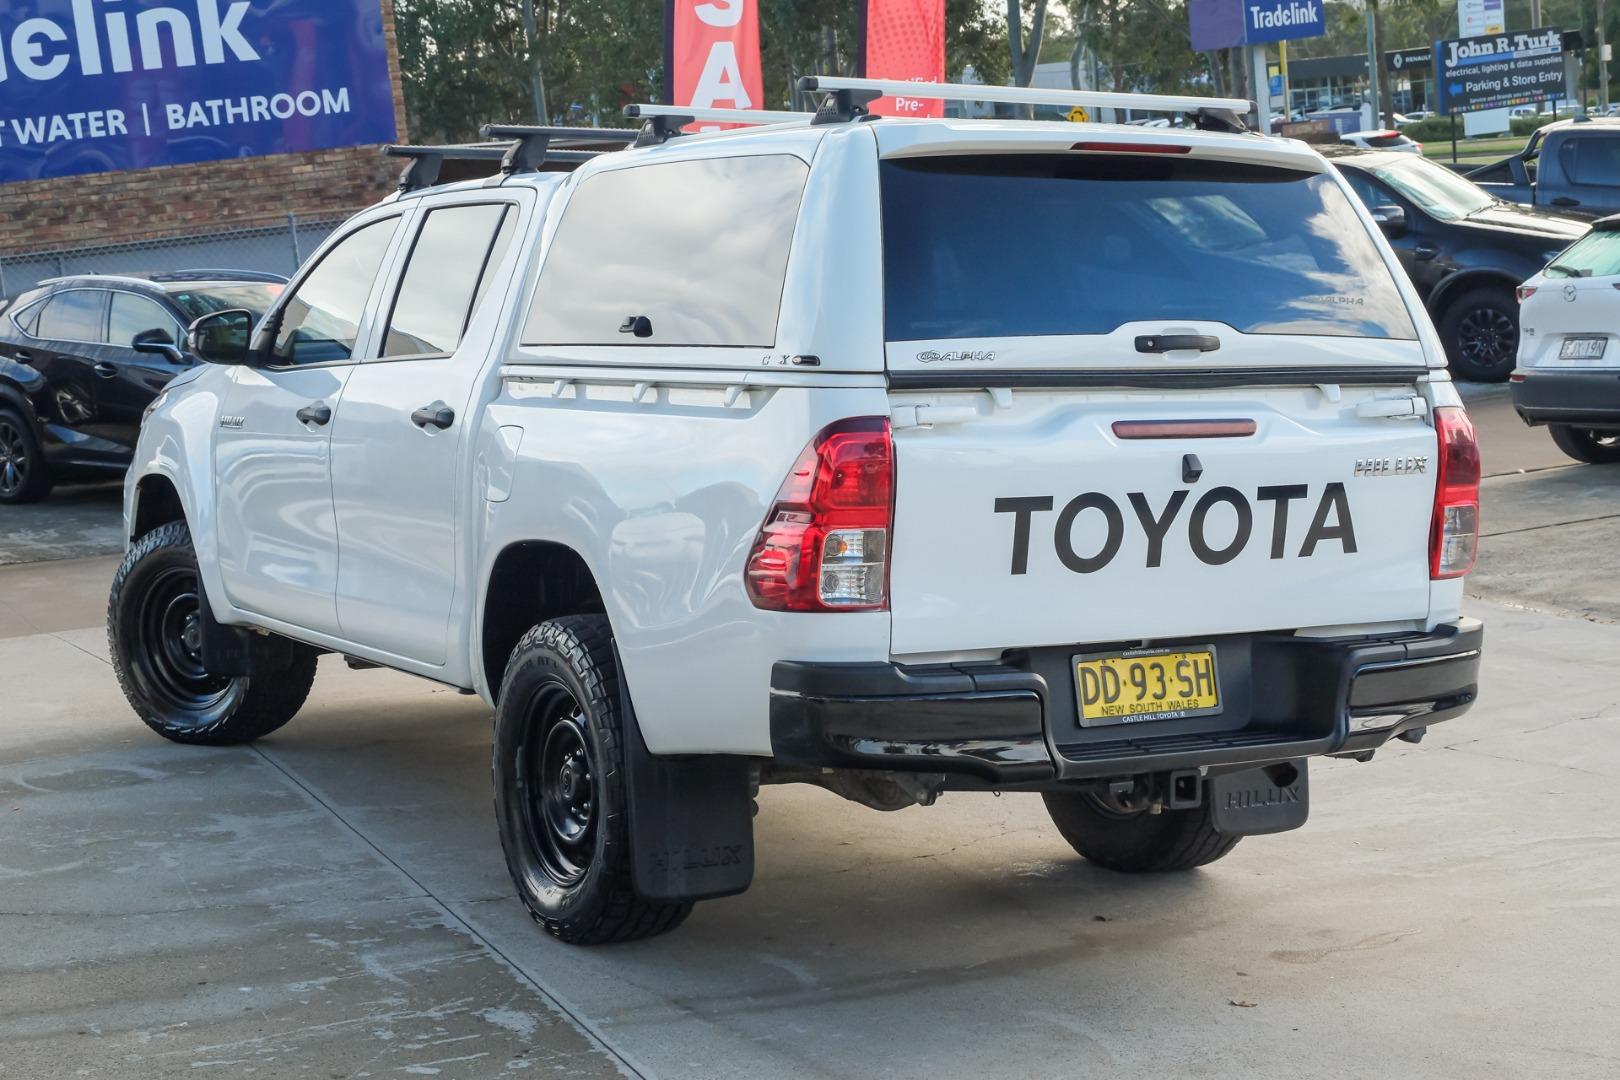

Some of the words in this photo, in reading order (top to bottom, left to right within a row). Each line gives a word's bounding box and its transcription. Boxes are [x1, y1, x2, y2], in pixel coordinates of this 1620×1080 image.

[1250, 1, 1318, 29] Tradelink
[0, 0, 261, 82] elink
[1405, 54, 1432, 63] RENAULT
[1445, 40, 1494, 67] John
[1481, 61, 1508, 73] lighting
[1516, 59, 1532, 68] data
[1534, 55, 1562, 67] supplies
[1465, 79, 1501, 92] Parking
[1503, 77, 1510, 87] &
[1512, 74, 1537, 86] Store
[1538, 71, 1563, 82] Entry
[895, 97, 924, 112] Pre-
[12, 109, 127, 145] WATER
[165, 87, 351, 130] BATHROOM
[940, 350, 996, 361] ALPHA
[994, 481, 1358, 575] TOYOTA
[1101, 704, 1124, 716] NEW
[1129, 701, 1163, 714] SOUTH
[1167, 699, 1199, 711] WALES
[1122, 715, 1144, 723] CASTLE
[1144, 714, 1157, 722] HILL
[1157, 711, 1178, 720] TOYOTA
